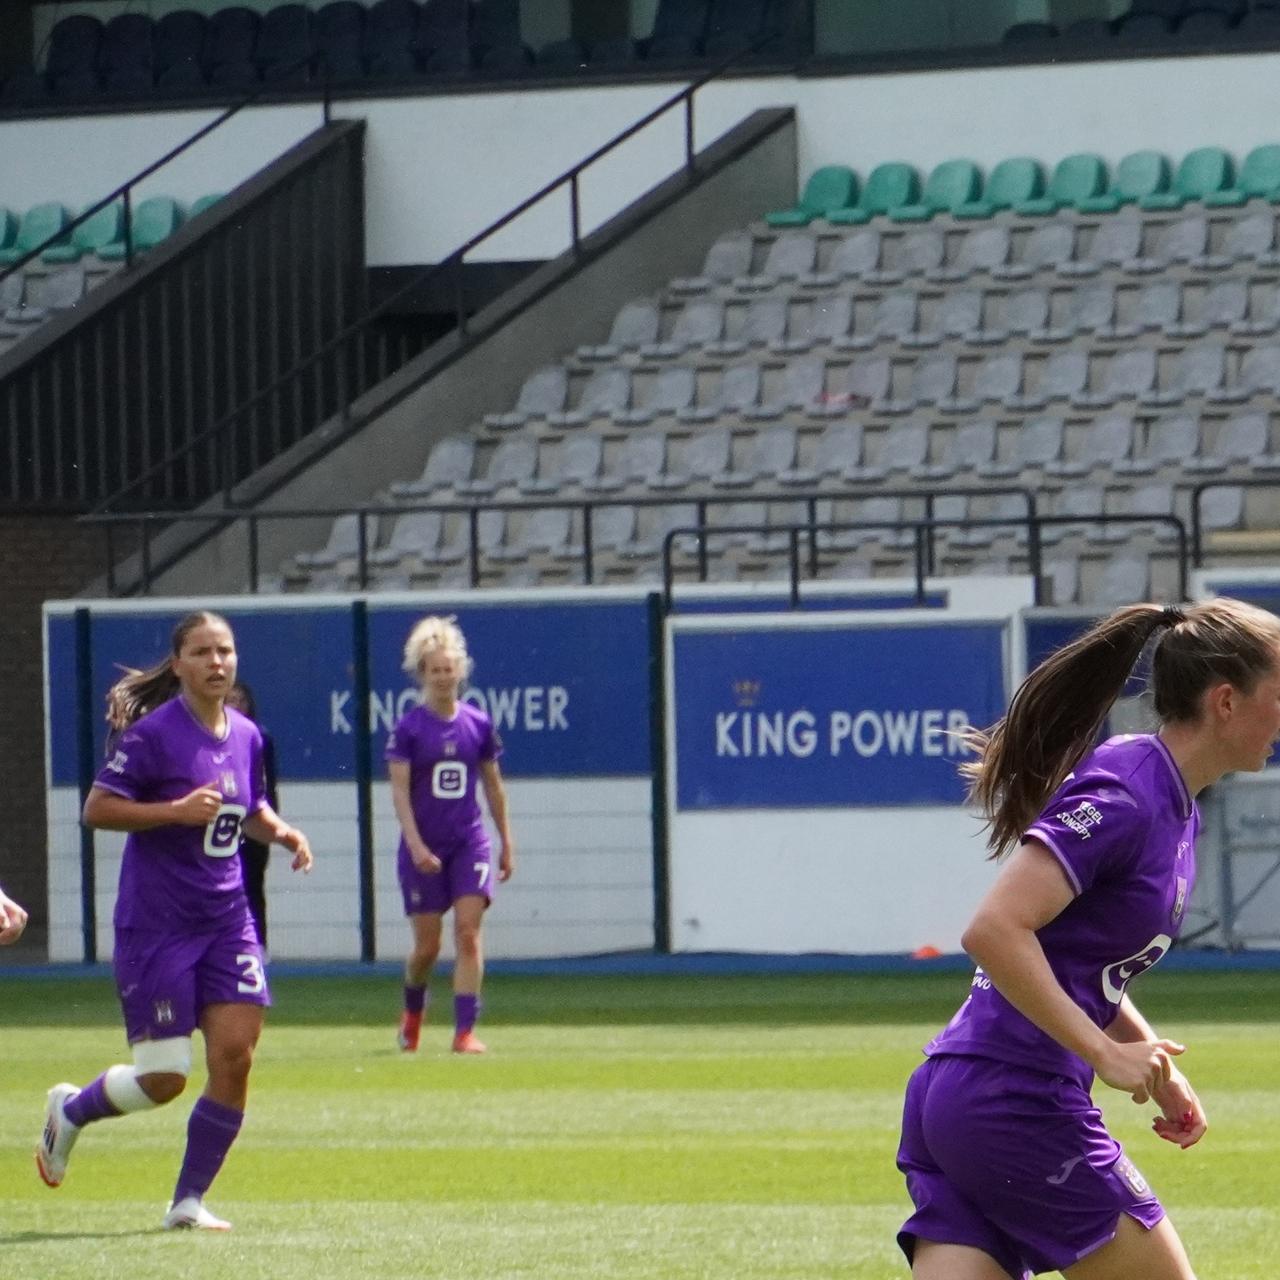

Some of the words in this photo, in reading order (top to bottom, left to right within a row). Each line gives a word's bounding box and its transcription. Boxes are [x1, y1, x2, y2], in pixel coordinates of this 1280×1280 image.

[715, 710, 818, 758] KING
[830, 709, 970, 758] POWER
[473, 862, 490, 889] 7
[236, 954, 263, 994] 3
